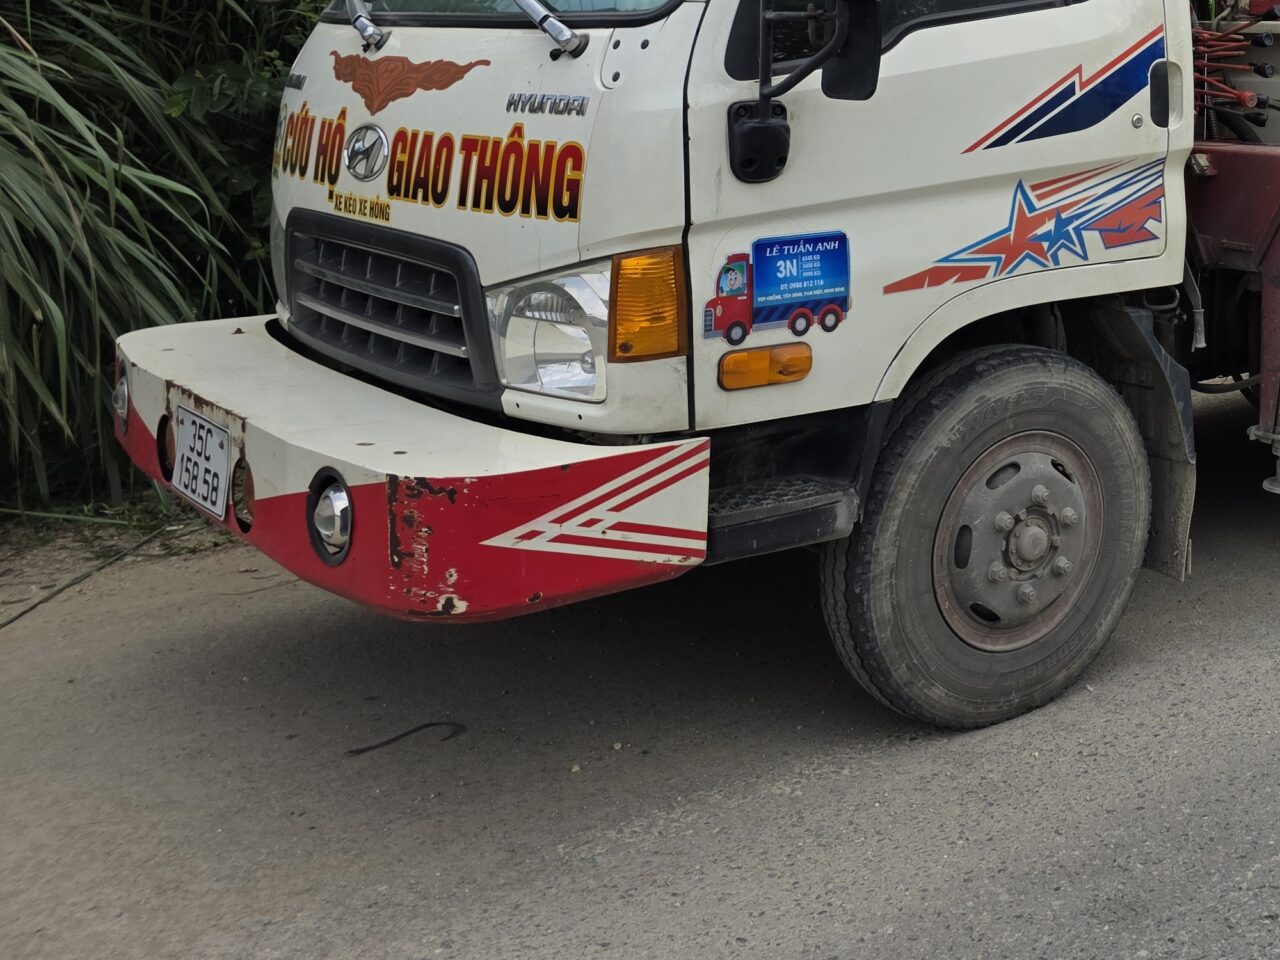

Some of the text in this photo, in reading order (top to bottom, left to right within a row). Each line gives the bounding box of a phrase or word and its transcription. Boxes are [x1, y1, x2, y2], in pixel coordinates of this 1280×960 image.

[506, 93, 590, 117] HYUNDAI
[282, 101, 316, 181] CỨU
[313, 107, 348, 202] HỘ
[387, 127, 455, 208] GIAO
[458, 123, 586, 223] THÔNG
[335, 193, 343, 211] XE
[344, 192, 357, 215] KÉO
[358, 198, 368, 216] XE
[766, 239, 839, 257] LÊ TUẤN ANH
[776, 258, 798, 279] 3N
[814, 279, 824, 287] 116
[189, 419, 214, 463] 35C
[179, 452, 220, 507] 158.58
